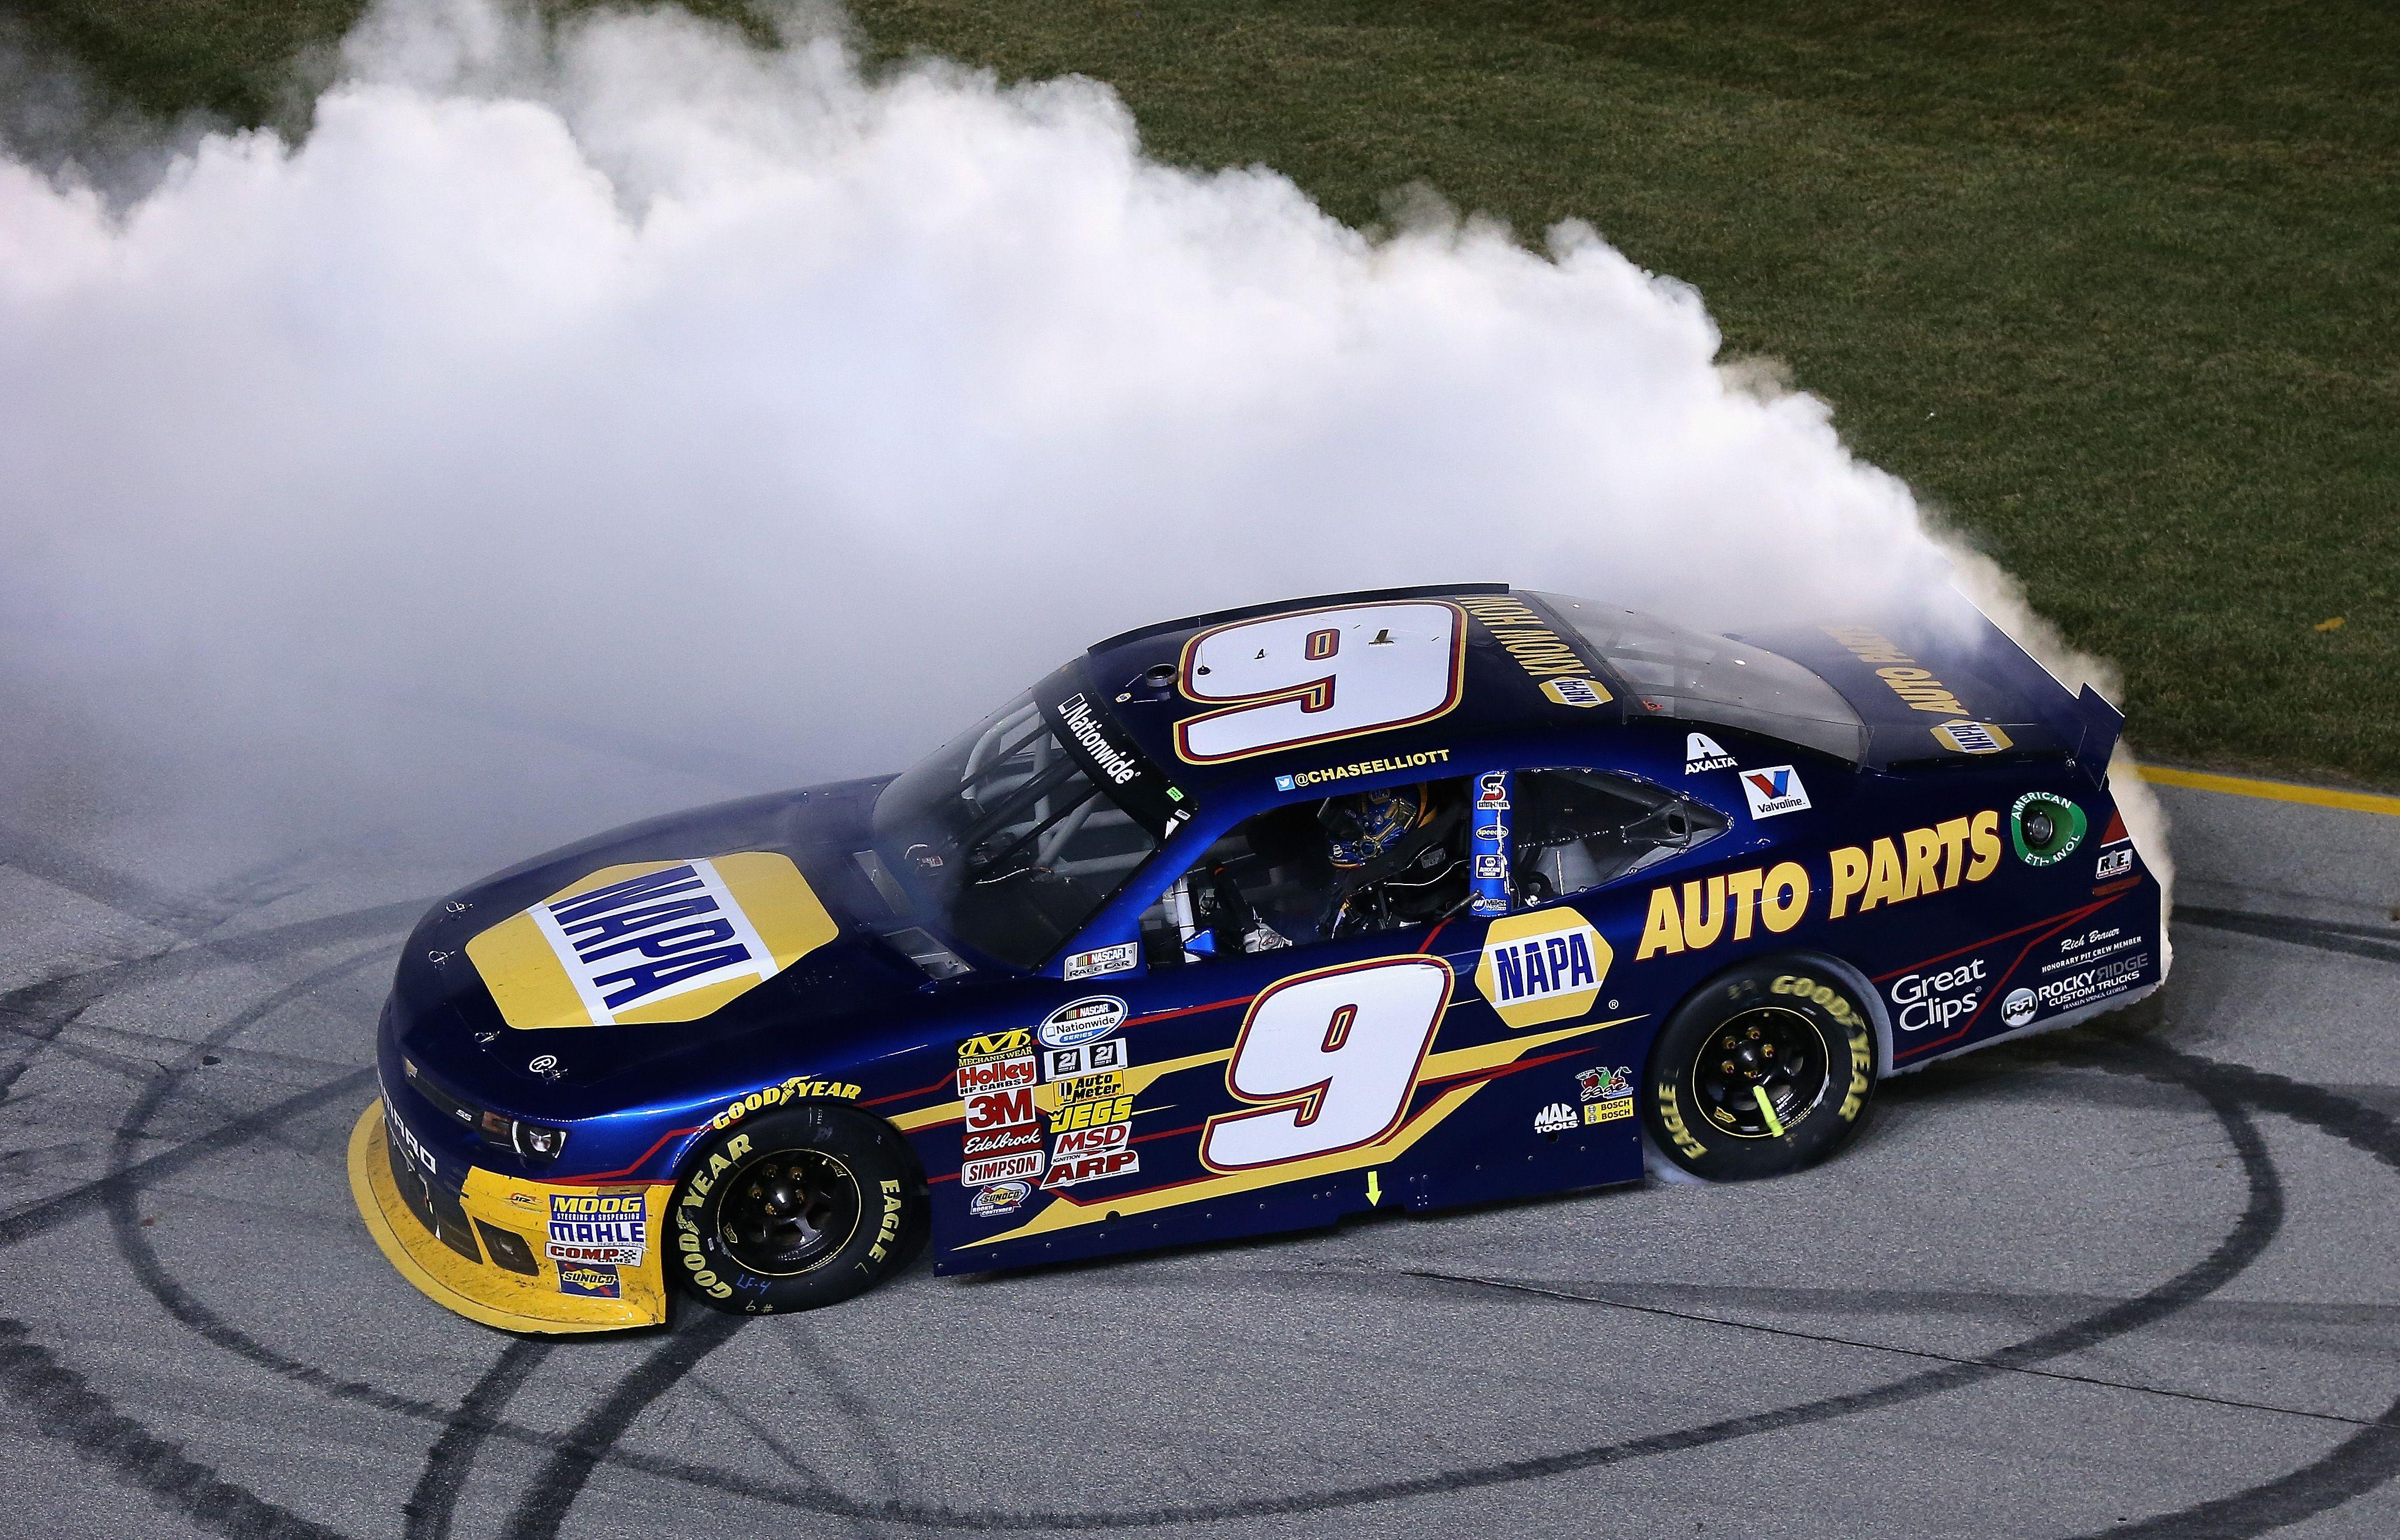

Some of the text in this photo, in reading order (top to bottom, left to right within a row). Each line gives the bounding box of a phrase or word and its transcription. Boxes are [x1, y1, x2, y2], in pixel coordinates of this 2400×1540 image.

[1455, 597, 1591, 676] KNOW HOW
[1174, 600, 1468, 765] 9
[1554, 680, 1599, 702] NAPA
[1875, 666, 1969, 715] AUTO
[1063, 702, 1134, 784] Nationwide
[1947, 724, 1998, 751] NAPA
[1295, 749, 1450, 786] @CHASEELLIOTT
[1685, 757, 1738, 775] AXALTA
[1757, 799, 1803, 813] Valvoline
[2011, 792, 2072, 821] AMERICAN
[1634, 810, 2002, 962] AUTO PARTS
[548, 865, 753, 1010] NAPA
[1091, 948, 1125, 964] NASCAR
[1104, 960, 1131, 970] CAR
[2042, 936, 2142, 973] HONORARY PIT CREW MEMBER
[1495, 933, 1595, 1001] NAPA
[1891, 959, 1986, 1004] Great
[2049, 970, 2140, 1007] CUSTOM TRUCKS
[1080, 1003, 1110, 1017] NASCAR
[1899, 993, 1978, 1031] Clips
[1057, 1017, 1115, 1034] Nationwide
[1063, 1031, 1094, 1041] SERIES
[959, 1047, 1033, 1067] MECHANIX WEAR
[1058, 1051, 1077, 1068] 21
[1094, 1045, 1114, 1062] 21
[1199, 954, 1455, 1175] 9
[959, 1061, 1034, 1088] Holley
[980, 1079, 1021, 1091] CARBS
[1075, 1074, 1113, 1090] Auto
[1074, 1083, 1122, 1101] Meter
[455, 1109, 472, 1122] SS
[969, 1088, 1033, 1128] 3M
[1050, 1096, 1133, 1133] JEGS
[1534, 1103, 1578, 1126] MAC
[1601, 1099, 1630, 1111] BOSCH
[1601, 1109, 1631, 1119] BOSCH
[1534, 1121, 1578, 1134] TOOLS
[964, 1128, 1041, 1154] Edelbrock
[1057, 1125, 1127, 1154] MSD
[969, 1155, 1037, 1181] SIMPSON
[1044, 1151, 1137, 1185] ARP
[1053, 1154, 1081, 1164] IGNITION
[553, 1196, 643, 1213] MOOG
[983, 1191, 1021, 1202] SUNOCO
[557, 1213, 589, 1221] STEERING
[598, 1213, 640, 1221] SUSPENSION
[869, 1179, 901, 1263] EAGLE
[549, 1222, 645, 1243] MAHLE
[550, 1246, 619, 1260] COMP
[563, 1272, 616, 1285] SUNOCO
